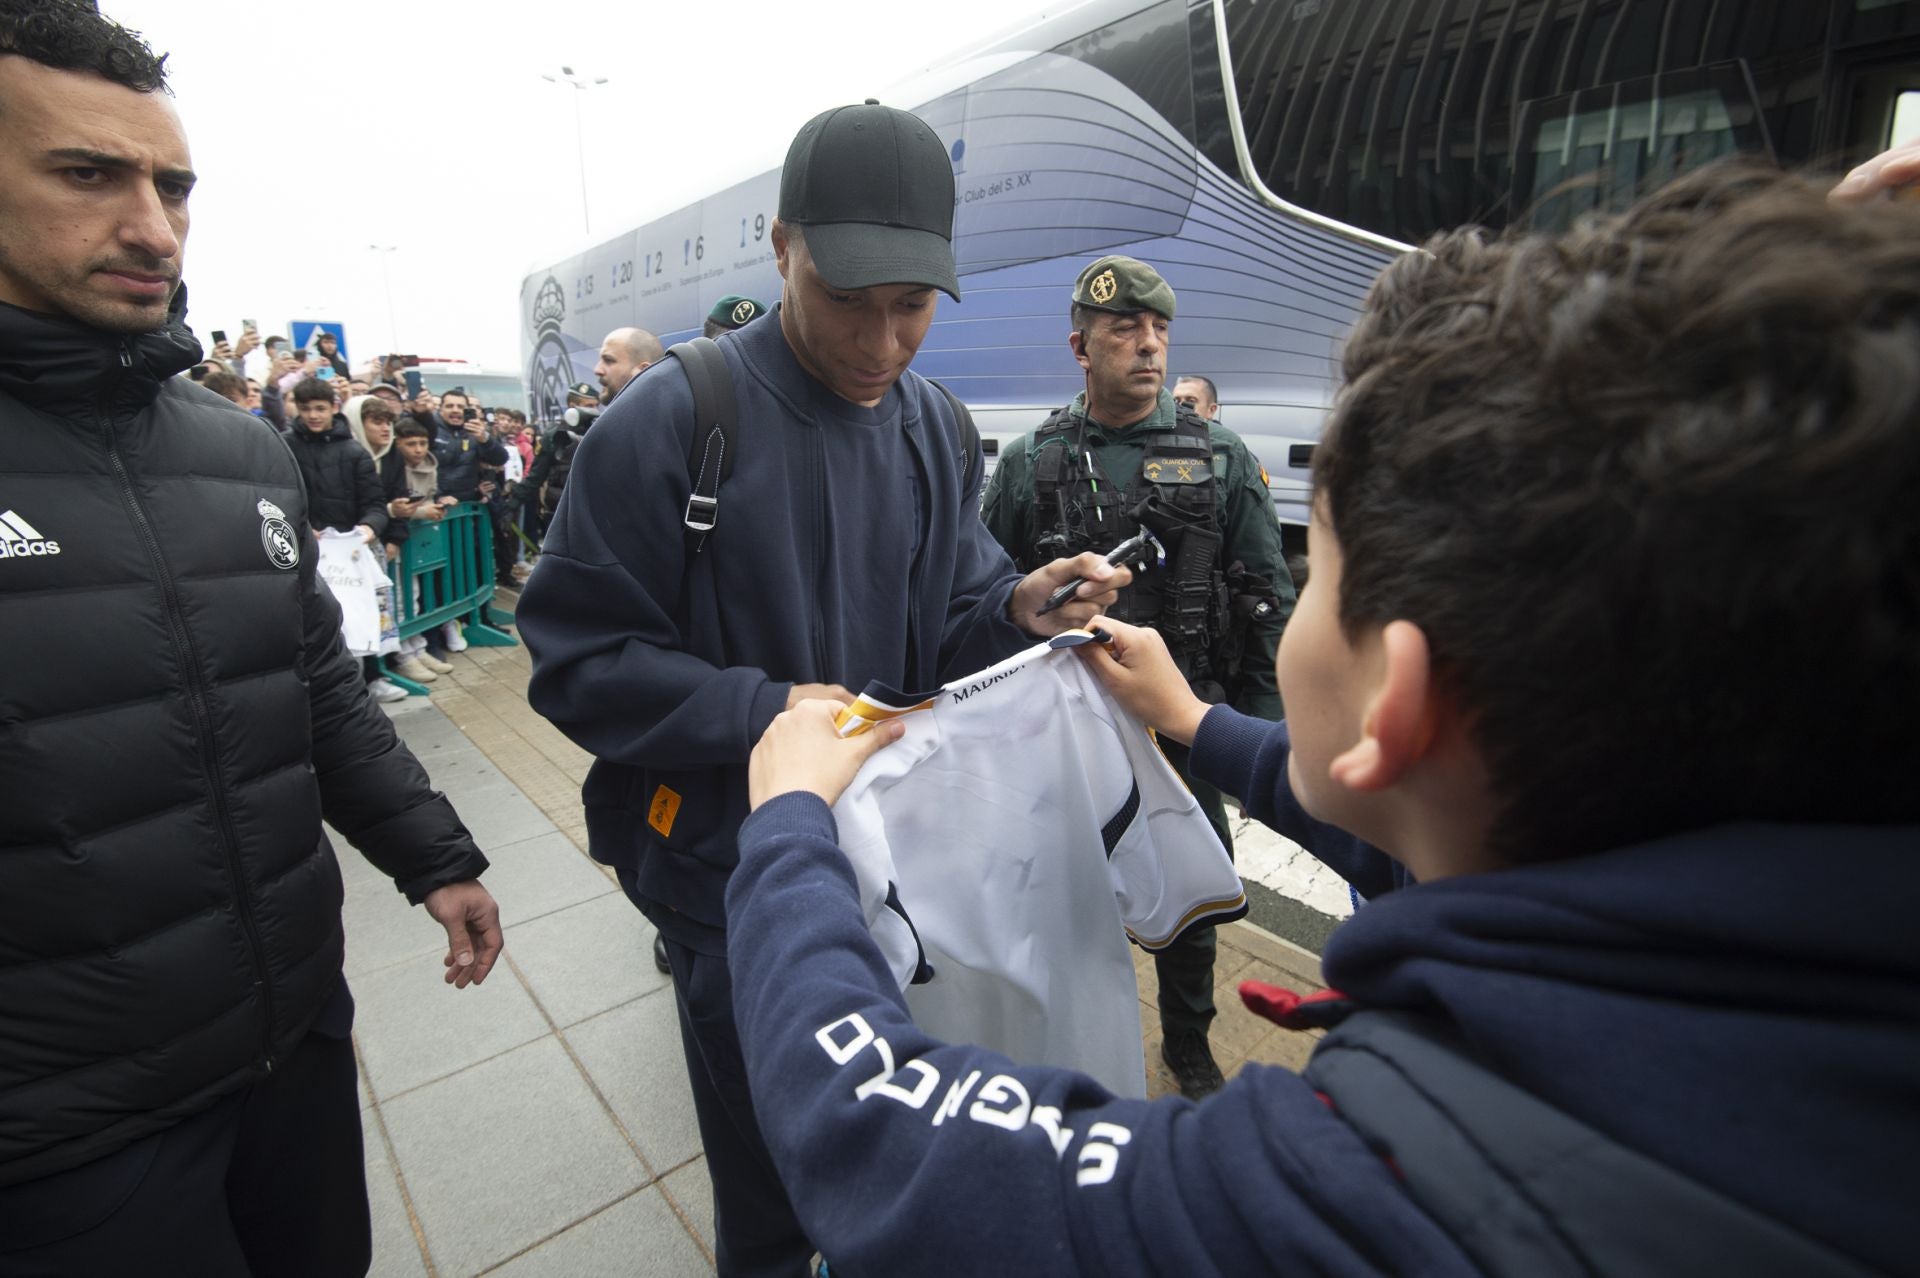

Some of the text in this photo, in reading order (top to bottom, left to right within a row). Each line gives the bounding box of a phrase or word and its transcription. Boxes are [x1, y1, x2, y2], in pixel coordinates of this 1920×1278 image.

[964, 187, 986, 204] Club
[987, 181, 1003, 197] del
[1017, 170, 1032, 189] XX
[754, 213, 765, 242] 9
[695, 235, 704, 261] 6
[619, 260, 633, 284] 20
[655, 251, 663, 275] 2
[1161, 458, 1189, 466] GUARDIA
[0, 538, 61, 558] didas
